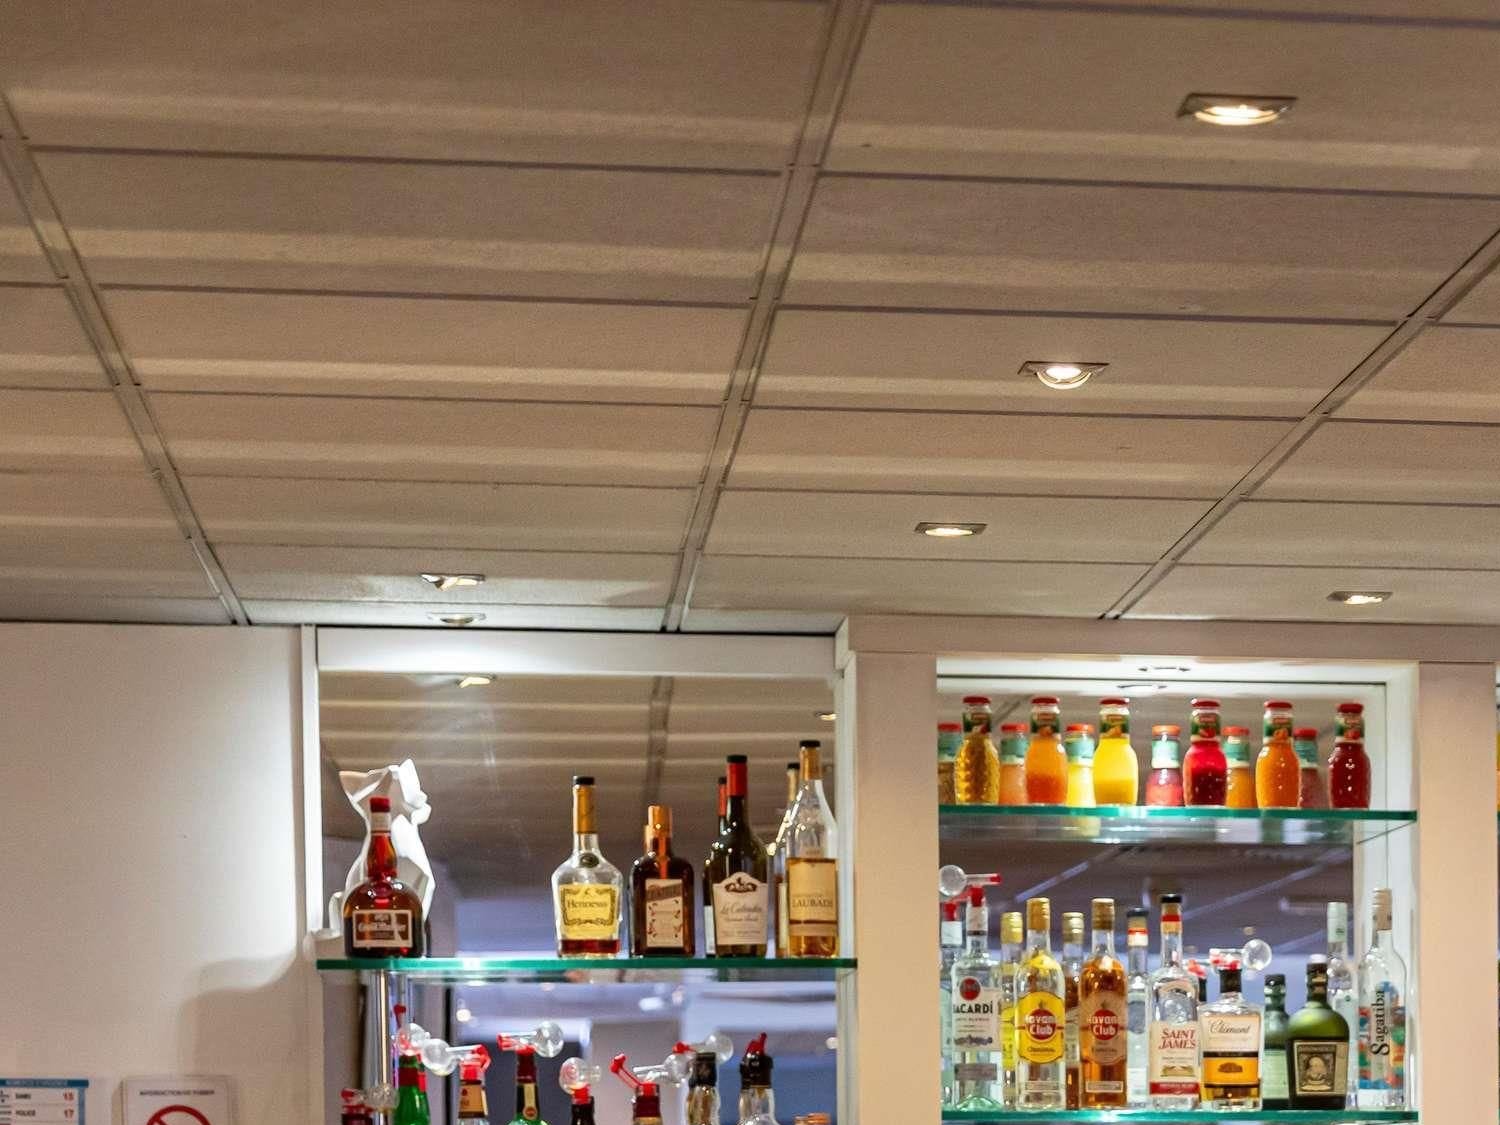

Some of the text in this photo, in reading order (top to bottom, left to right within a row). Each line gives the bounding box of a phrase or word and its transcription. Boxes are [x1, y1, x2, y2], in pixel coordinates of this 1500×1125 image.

[1029, 1023, 1053, 1035] Club
[1092, 1023, 1116, 1035] Club
[1161, 1028, 1195, 1039] SAINT
[1158, 1039, 1196, 1049] JAMES
[64, 1109, 74, 1118] 17
